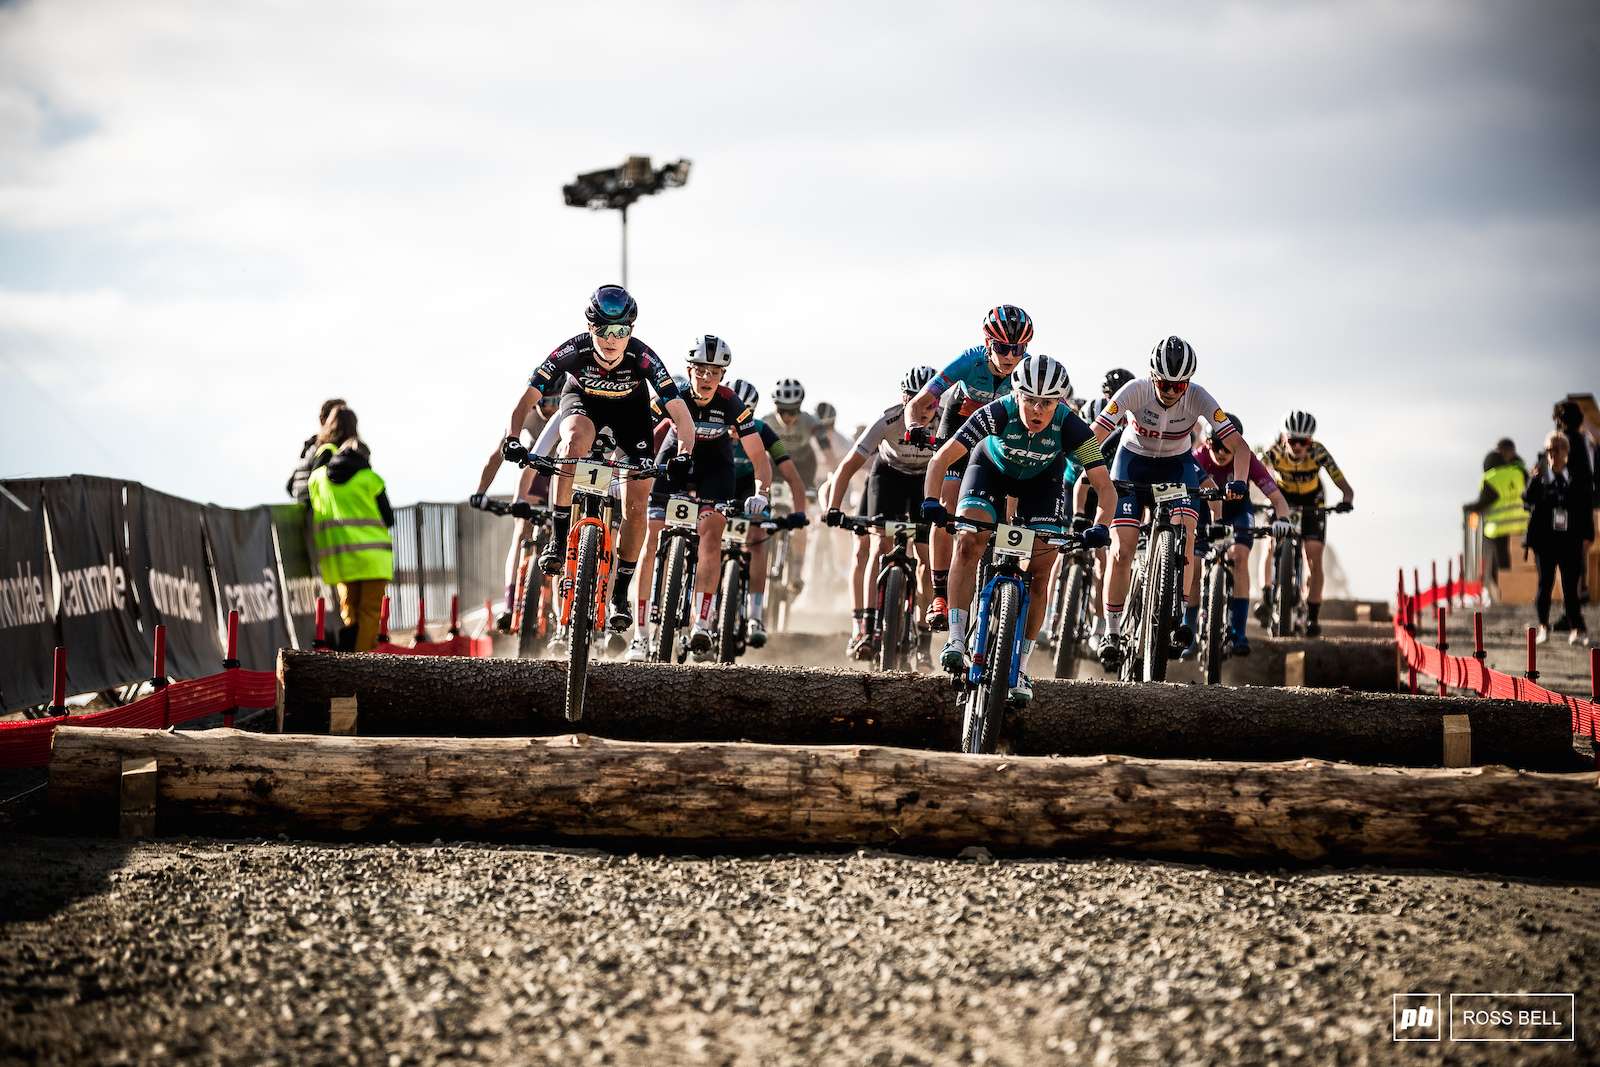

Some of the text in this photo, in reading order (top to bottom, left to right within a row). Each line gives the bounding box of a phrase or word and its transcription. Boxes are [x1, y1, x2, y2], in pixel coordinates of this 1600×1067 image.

[1131, 419, 1160, 440] GBR
[588, 468, 598, 485] 1
[675, 504, 689, 519] 8
[726, 520, 746, 534] 14
[1008, 530, 1022, 546] 9
